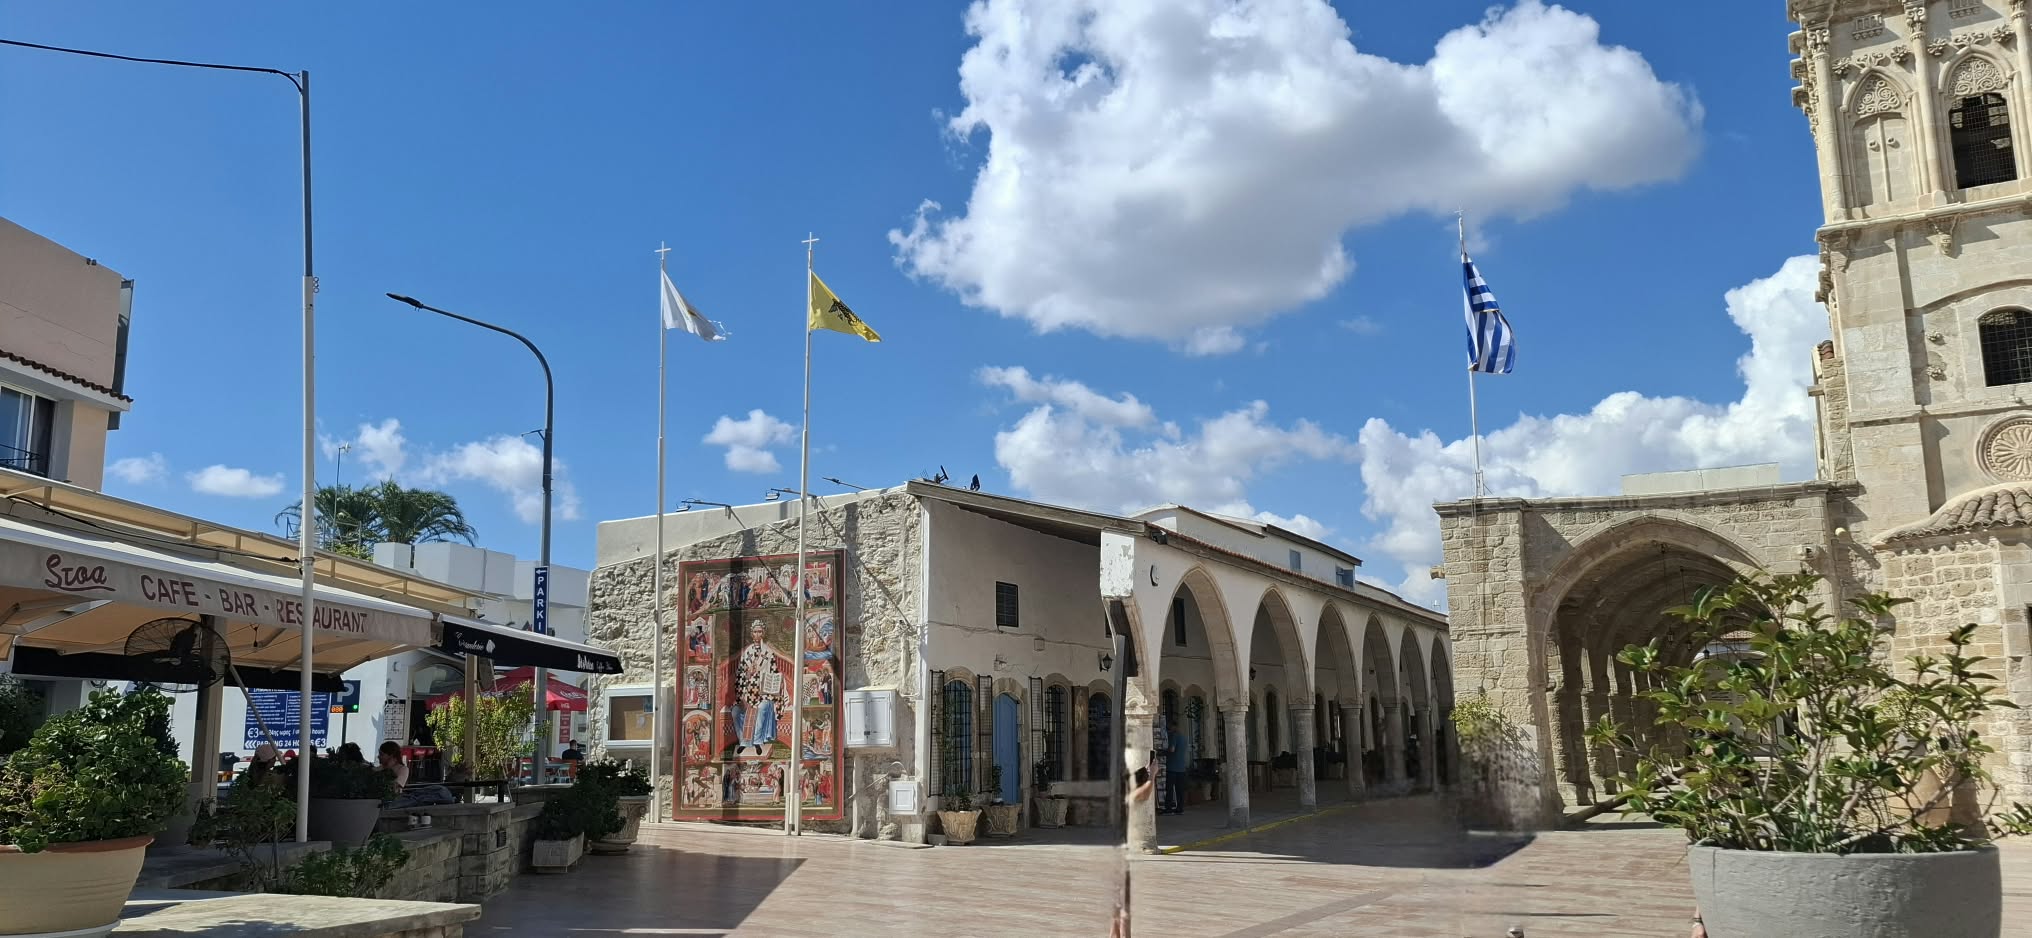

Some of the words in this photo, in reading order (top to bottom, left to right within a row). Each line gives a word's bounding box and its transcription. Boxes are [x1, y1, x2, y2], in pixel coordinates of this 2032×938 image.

[140, 574, 199, 607] CAFE
[219, 588, 258, 617] BAR
[276, 599, 368, 633] RESAURANT
[536, 576, 545, 631] PARKI
[247, 727, 259, 738] €3
[314, 738, 326, 747] €3
